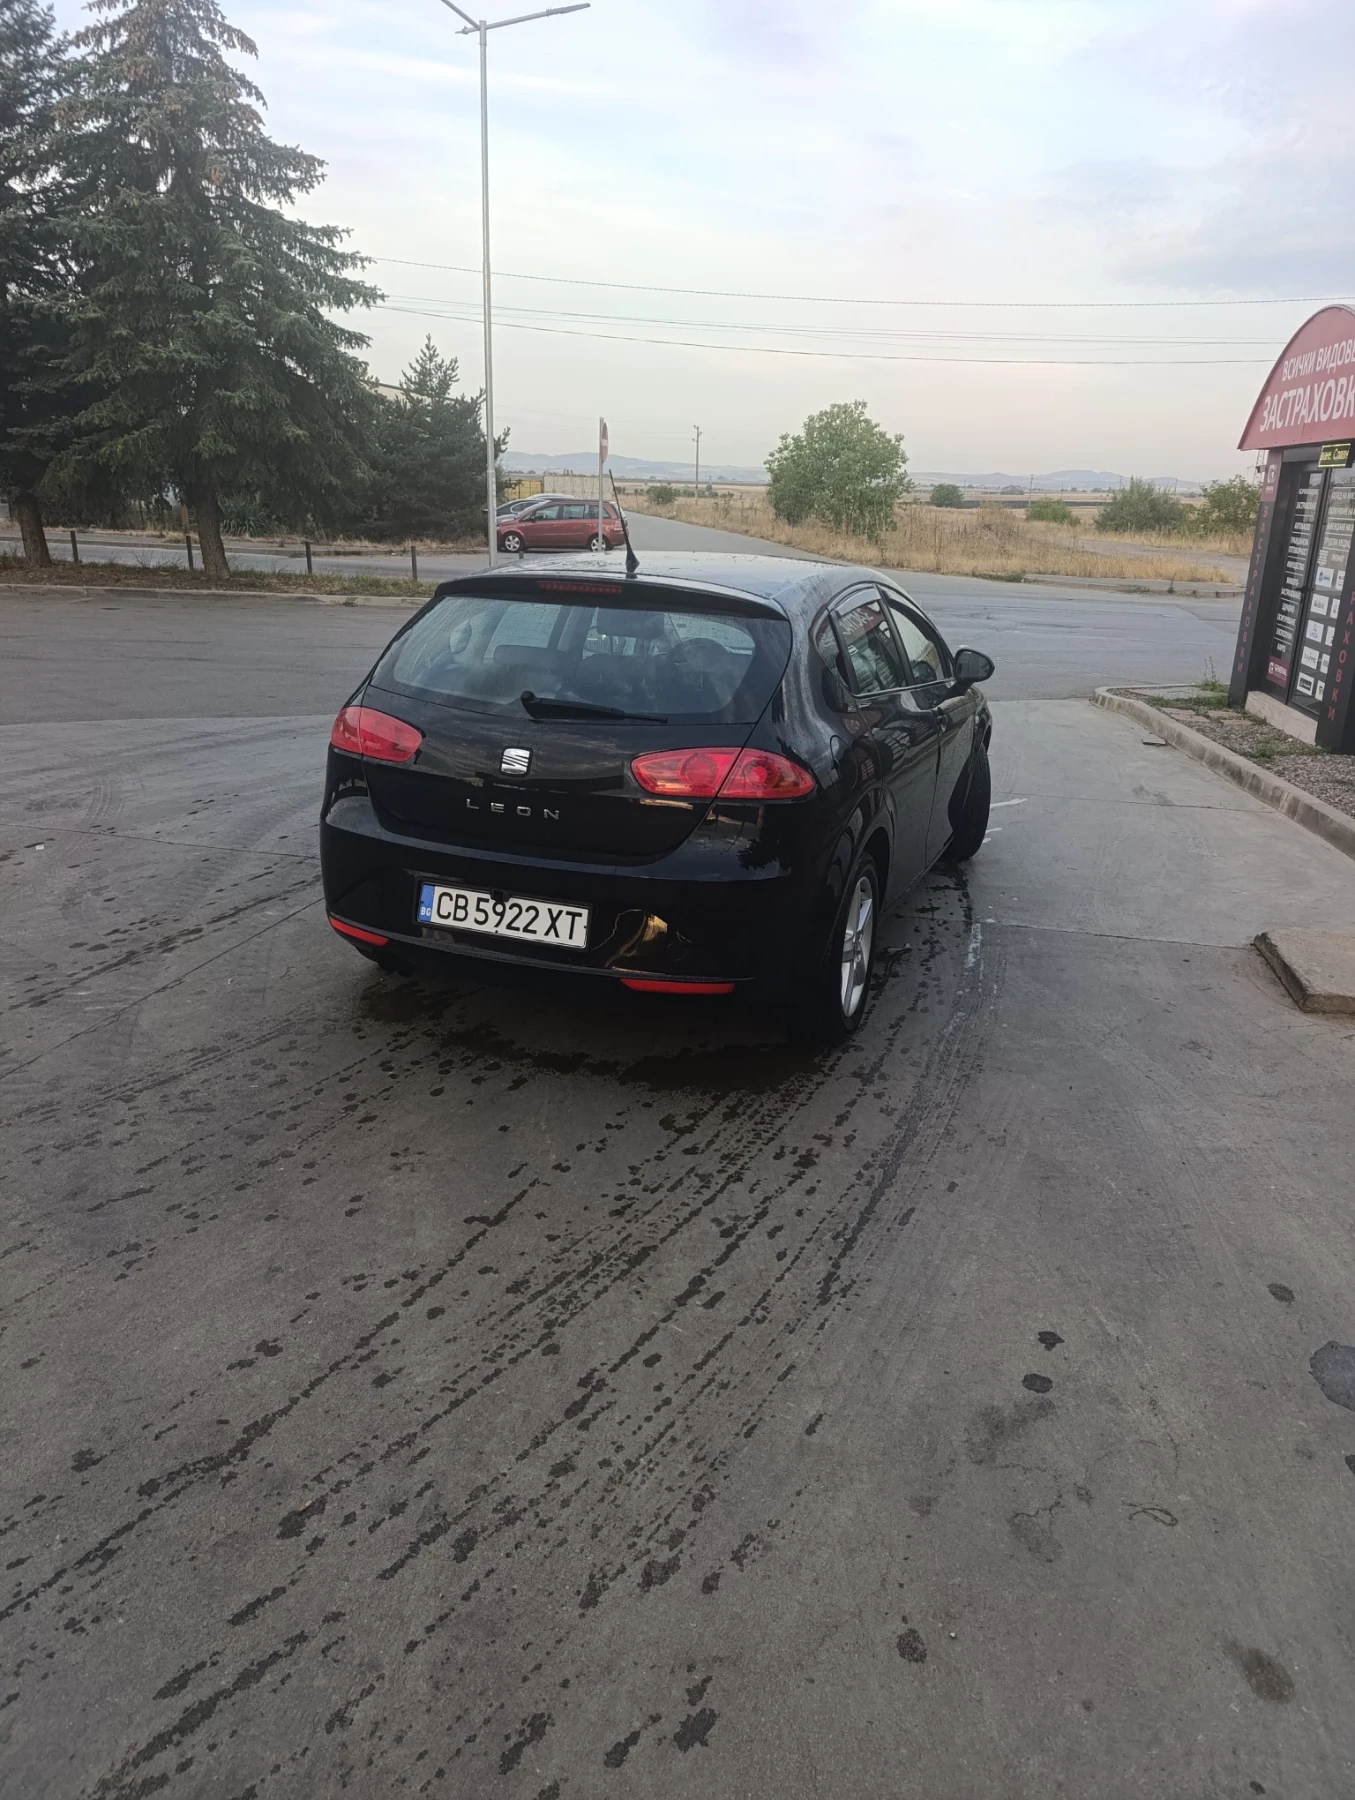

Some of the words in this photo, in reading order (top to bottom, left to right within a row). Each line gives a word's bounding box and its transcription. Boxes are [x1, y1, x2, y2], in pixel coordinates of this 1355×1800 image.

[1282, 351, 1317, 382] ВСИЧКИ
[1237, 505, 1269, 672] ЗАСТРАХОВКИ
[466, 798, 560, 820] LEON
[421, 907, 432, 916] BG
[436, 892, 469, 922] CB
[474, 897, 540, 934] 5922
[544, 908, 583, 940] XT
